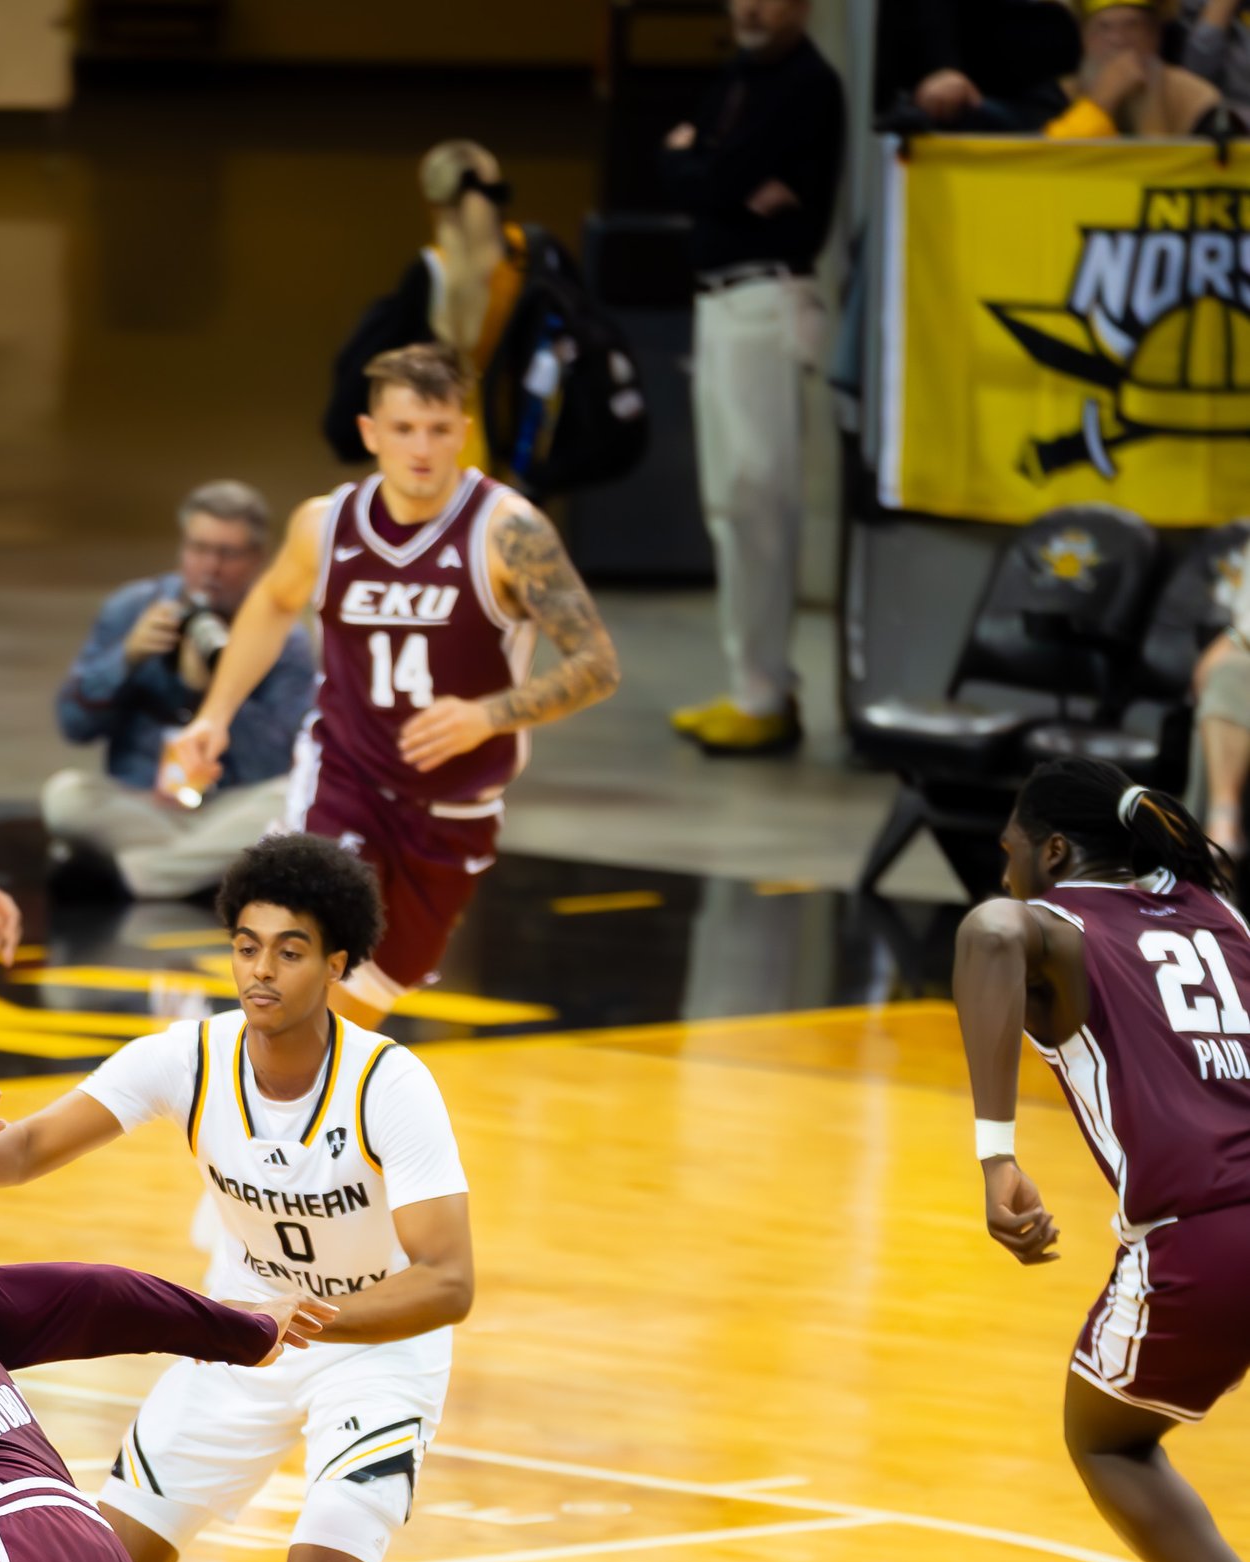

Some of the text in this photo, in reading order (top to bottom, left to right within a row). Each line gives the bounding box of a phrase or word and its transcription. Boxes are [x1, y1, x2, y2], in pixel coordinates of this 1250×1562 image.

[341, 580, 460, 621] EKU
[368, 630, 434, 710] 14
[1137, 929, 1250, 1034] 21
[208, 1164, 370, 1218] NORTHERN
[274, 1221, 315, 1264] 0
